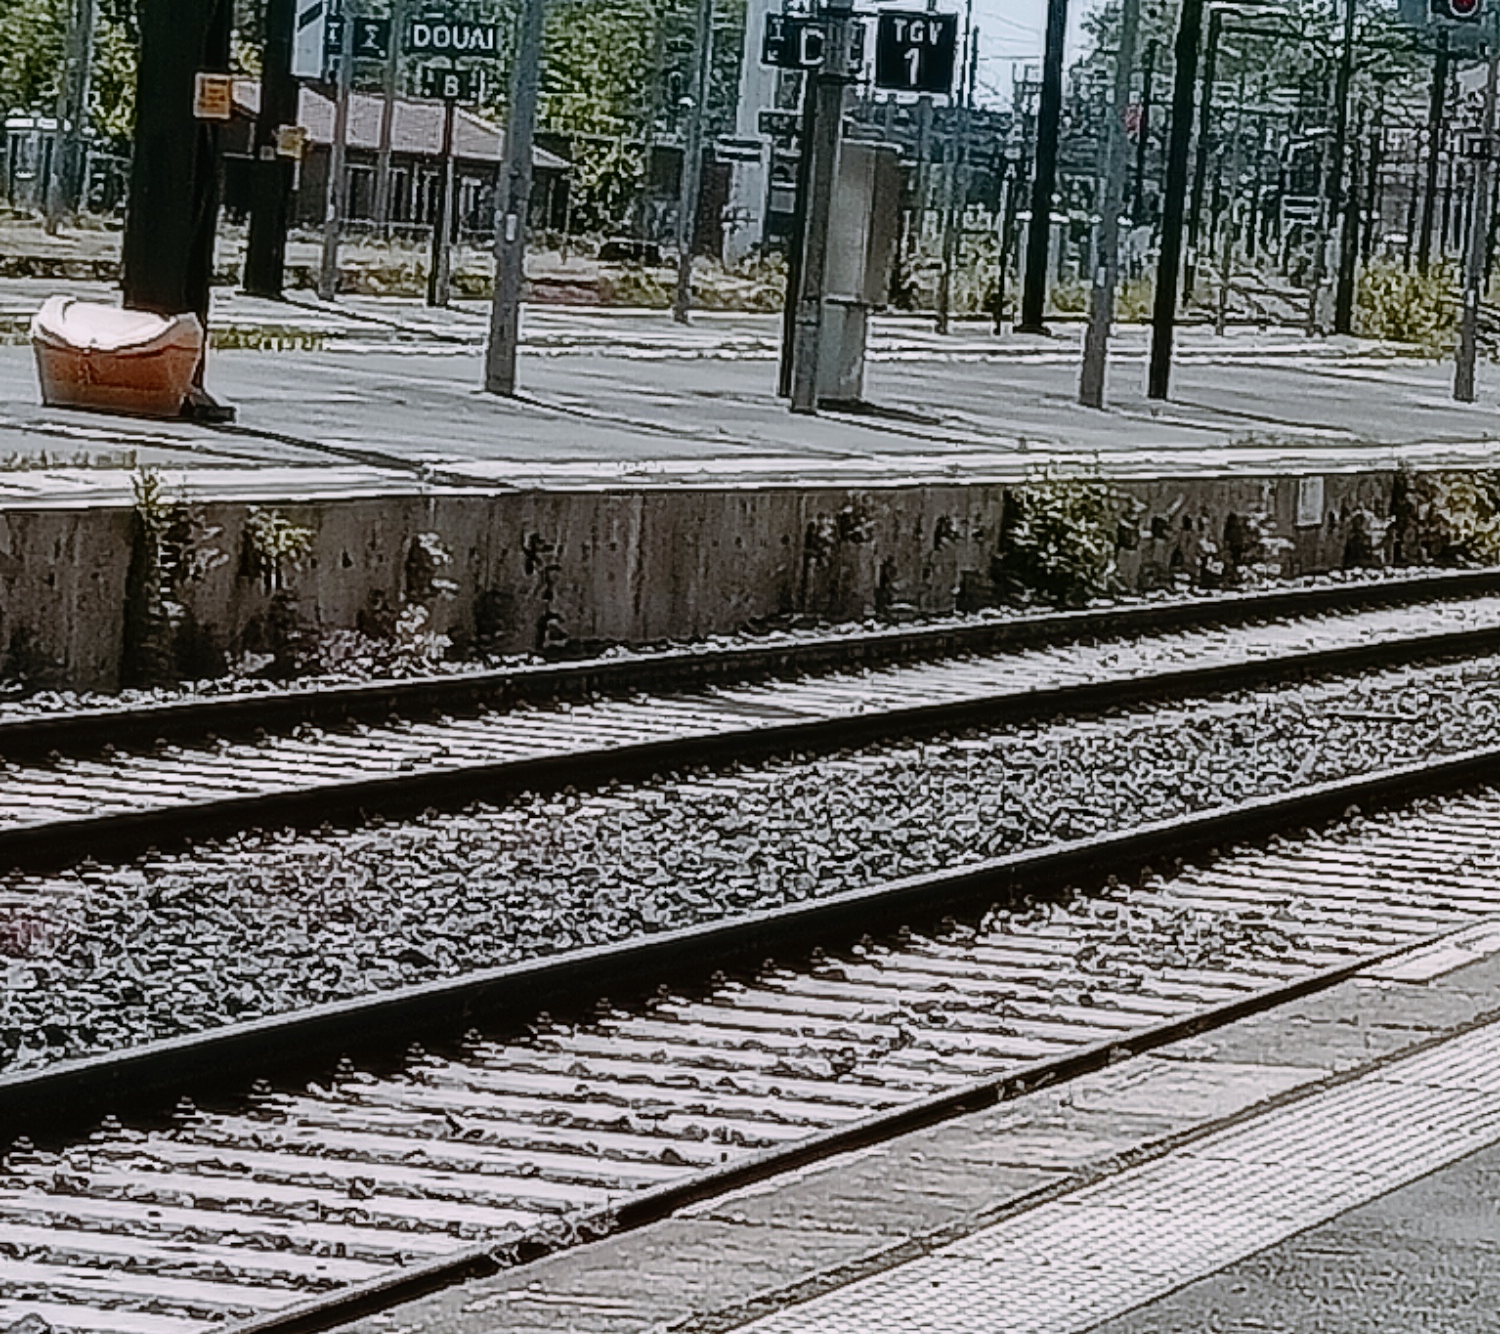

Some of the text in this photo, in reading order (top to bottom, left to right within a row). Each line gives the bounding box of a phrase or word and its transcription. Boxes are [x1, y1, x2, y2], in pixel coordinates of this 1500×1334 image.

[413, 23, 494, 50] DOUAI
[893, 17, 943, 46] TGV
[904, 47, 920, 86] 1
